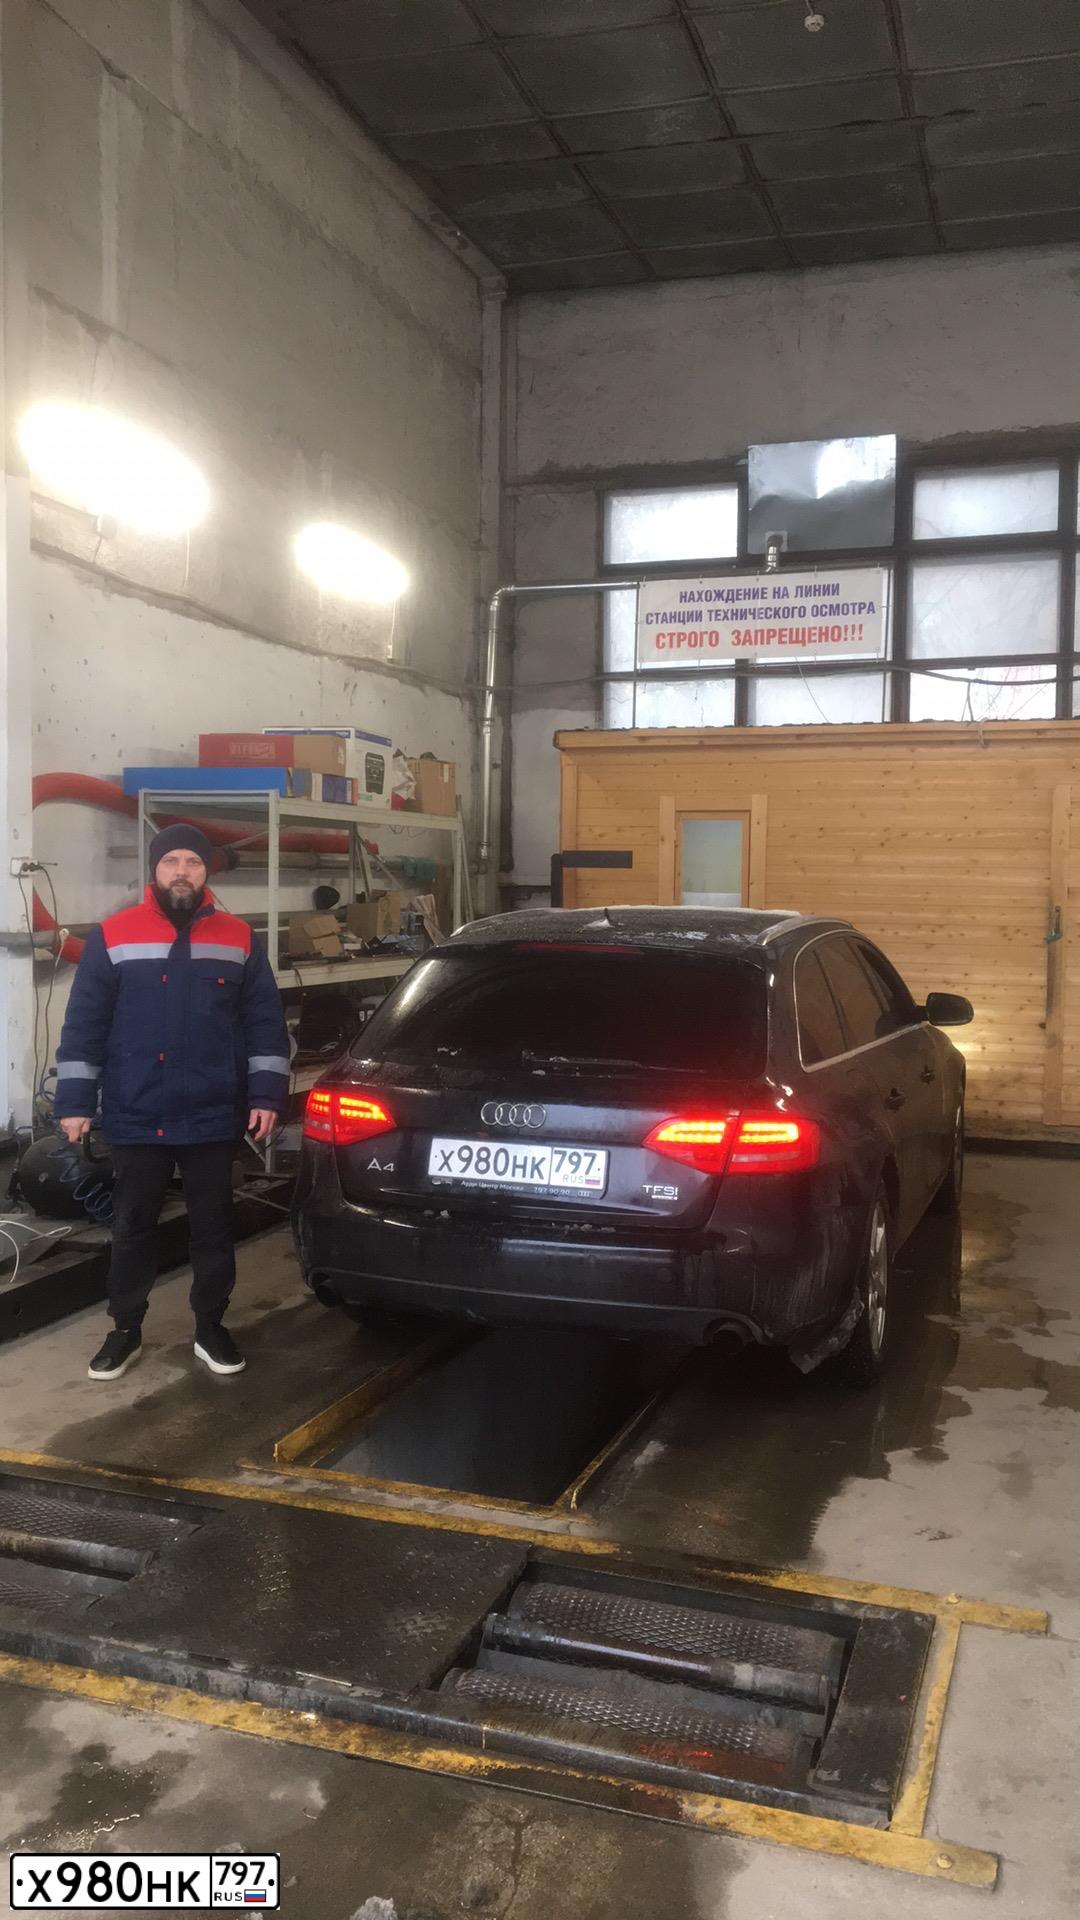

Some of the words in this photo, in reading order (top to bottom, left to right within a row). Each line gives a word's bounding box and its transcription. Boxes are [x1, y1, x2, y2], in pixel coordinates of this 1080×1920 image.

[679, 587, 768, 603] НАХОЖДЕНИЕ
[772, 586, 789, 599] НА
[794, 583, 840, 598] ЛИНИИ
[645, 611, 703, 625] СТАНЦИИ
[707, 605, 807, 623] ТЕХНИЧЕСКОГО
[811, 601, 876, 618] ОСМОТРА
[655, 630, 720, 650] СТРОГО
[731, 623, 864, 647] ЗАПРЕЩЕНО!!!
[367, 1157, 394, 1172] A4
[553, 1150, 598, 1175] 797
[562, 1174, 584, 1184] RUS
[642, 1184, 678, 1196] TFSI
